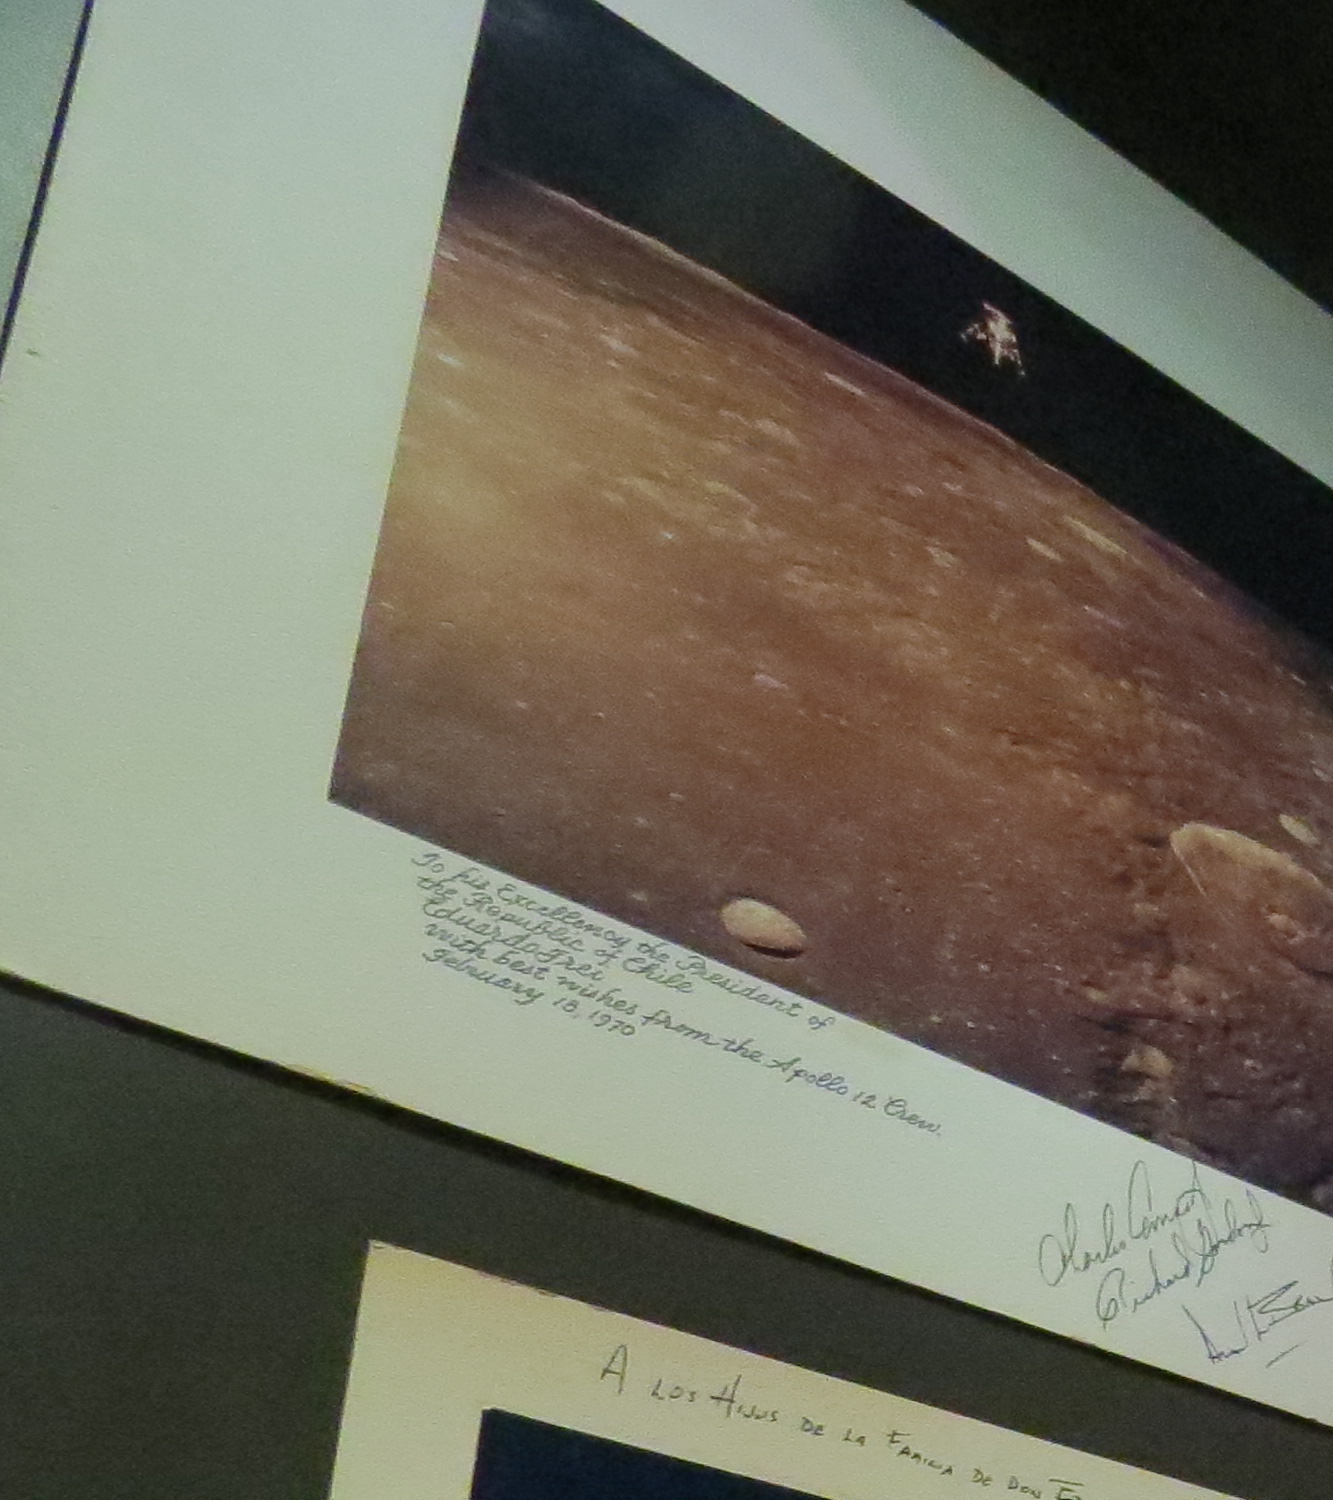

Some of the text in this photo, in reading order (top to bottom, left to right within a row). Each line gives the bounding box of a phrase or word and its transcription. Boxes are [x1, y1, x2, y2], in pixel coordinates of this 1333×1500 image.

[411, 852, 445, 874] To
[637, 941, 671, 964] the
[676, 954, 804, 1018] President
[807, 1014, 836, 1031] of
[416, 876, 694, 994] the Republic of Chile
[421, 946, 545, 1007] February
[587, 1010, 637, 1037] 1970
[423, 922, 489, 960] with
[492, 951, 551, 982] best
[556, 973, 640, 1016] wishes
[640, 1009, 721, 1047] from
[720, 1037, 765, 1065] the
[763, 1056, 849, 1097] Apollo
[850, 1090, 877, 1110] 12
[599, 1342, 629, 1395] A
